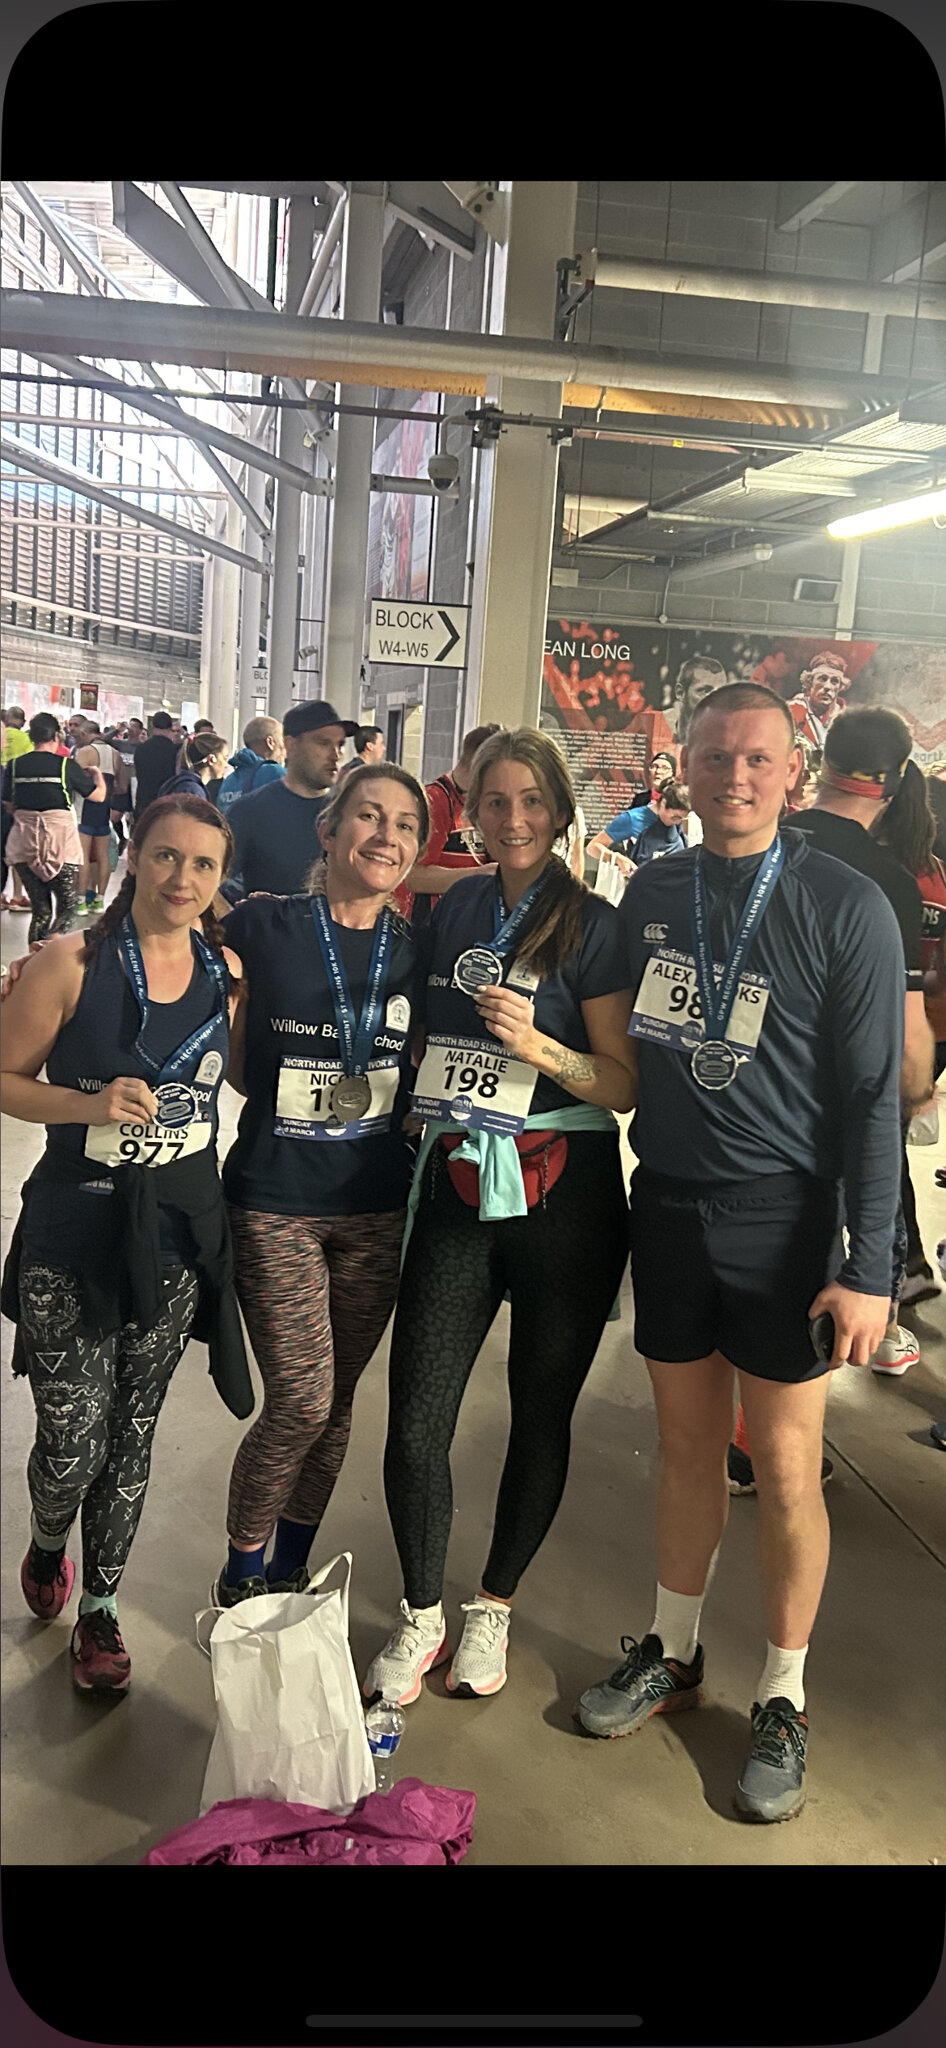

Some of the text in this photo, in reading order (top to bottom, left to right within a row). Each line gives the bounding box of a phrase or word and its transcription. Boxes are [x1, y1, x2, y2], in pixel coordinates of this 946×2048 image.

[375, 609, 434, 630] BLOCK
[378, 640, 429, 658] W4-W5
[544, 640, 631, 661] EAN LONG
[723, 945, 744, 1001] RECRUITMENT
[741, 930, 749, 939] ST
[745, 900, 762, 928] HELENS
[757, 884, 767, 898] 10K
[762, 869, 773, 883] Run
[657, 948, 686, 964] NORTH
[331, 962, 340, 974] 10K
[653, 963, 693, 985] ALEX
[334, 976, 346, 1002] HELENS
[340, 1005, 348, 1014] ST
[642, 1017, 669, 1030] SUNDAY
[271, 1018, 406, 1051] Willow Ba chool
[647, 1029, 671, 1041] MARCH
[429, 1036, 515, 1057] NORTH ROAD SURVIV
[283, 1058, 317, 1069] NORTH
[317, 1061, 344, 1070] ROAD
[444, 1050, 509, 1074] NATALIE
[444, 1065, 500, 1098] 198
[418, 1098, 441, 1107] SUNDAY
[423, 1108, 442, 1117] MARCH
[119, 1123, 189, 1140] COLLINS
[282, 1118, 311, 1128] SUNDAY
[288, 1127, 316, 1137] MARCH
[118, 1139, 185, 1165] 977
